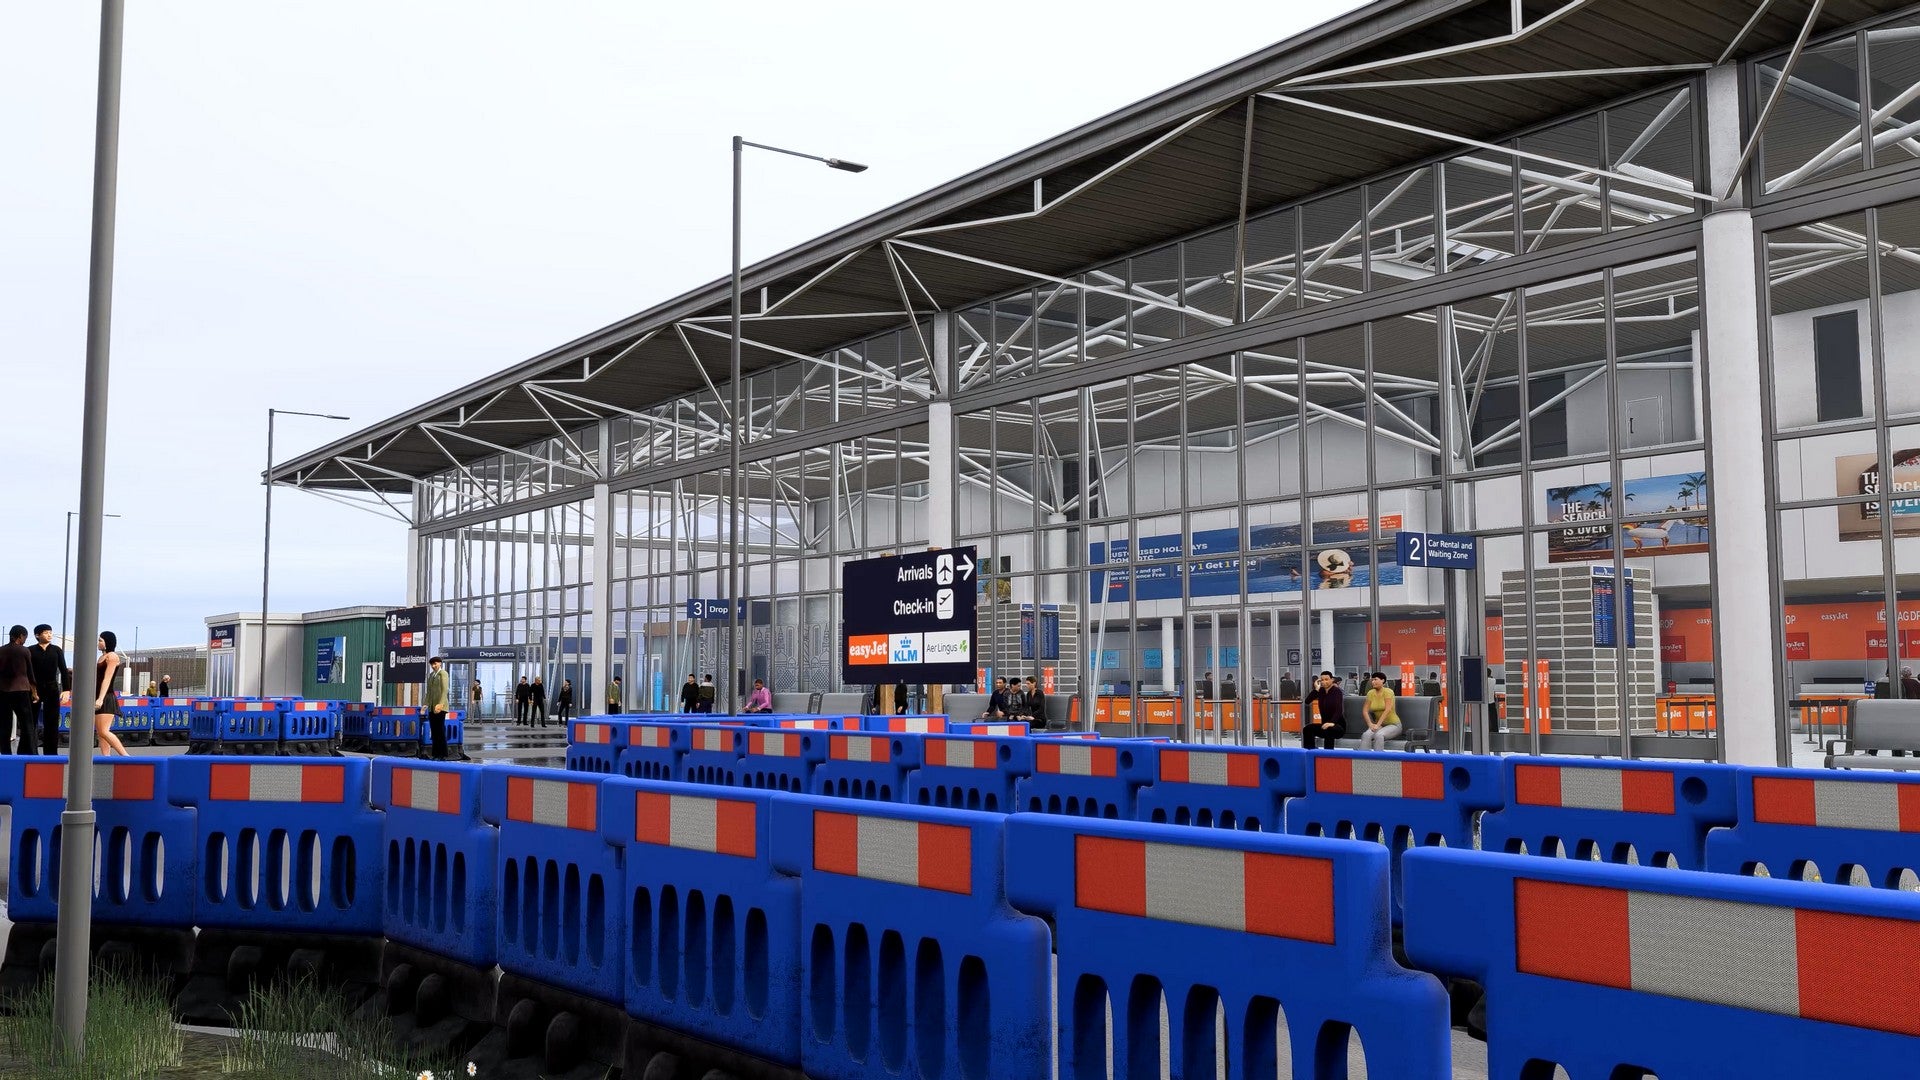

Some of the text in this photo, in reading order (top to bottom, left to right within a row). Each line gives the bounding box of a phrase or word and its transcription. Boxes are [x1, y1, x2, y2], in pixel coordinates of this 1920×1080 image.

[1862, 472, 1879, 485] TH
[1561, 502, 1582, 514] THE
[1563, 511, 1606, 522] SEARCH
[1409, 537, 1473, 561] 2 Car Rental and
[1428, 550, 1468, 560] Waiting Zone
[898, 565, 933, 582] Arrivals
[693, 602, 702, 616] 3
[709, 606, 728, 615] Drop
[894, 598, 934, 615] Check-in
[1821, 612, 1849, 622] easyJet
[1398, 627, 1416, 637] easyJet
[850, 641, 887, 658] easyJet
[894, 650, 918, 662] KLM
